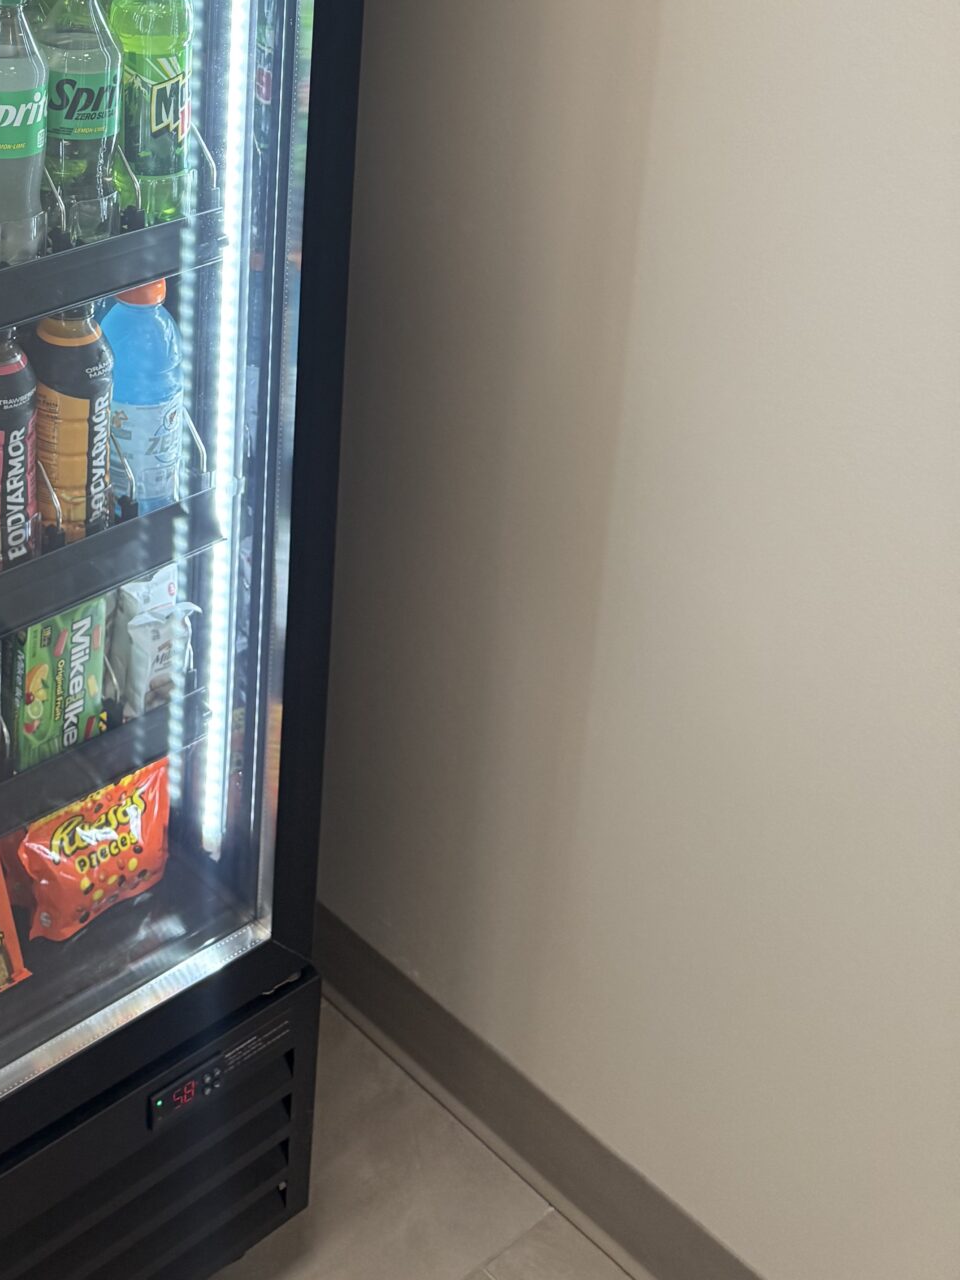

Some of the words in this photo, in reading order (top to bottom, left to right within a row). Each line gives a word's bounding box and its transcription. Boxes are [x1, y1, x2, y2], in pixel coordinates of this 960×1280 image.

[48, 74, 119, 120] Spri
[7, 426, 26, 562] BODYARMOR
[90, 392, 110, 523] BODYARMOR
[69, 616, 92, 695] Mike
[62, 696, 86, 747] Ike
